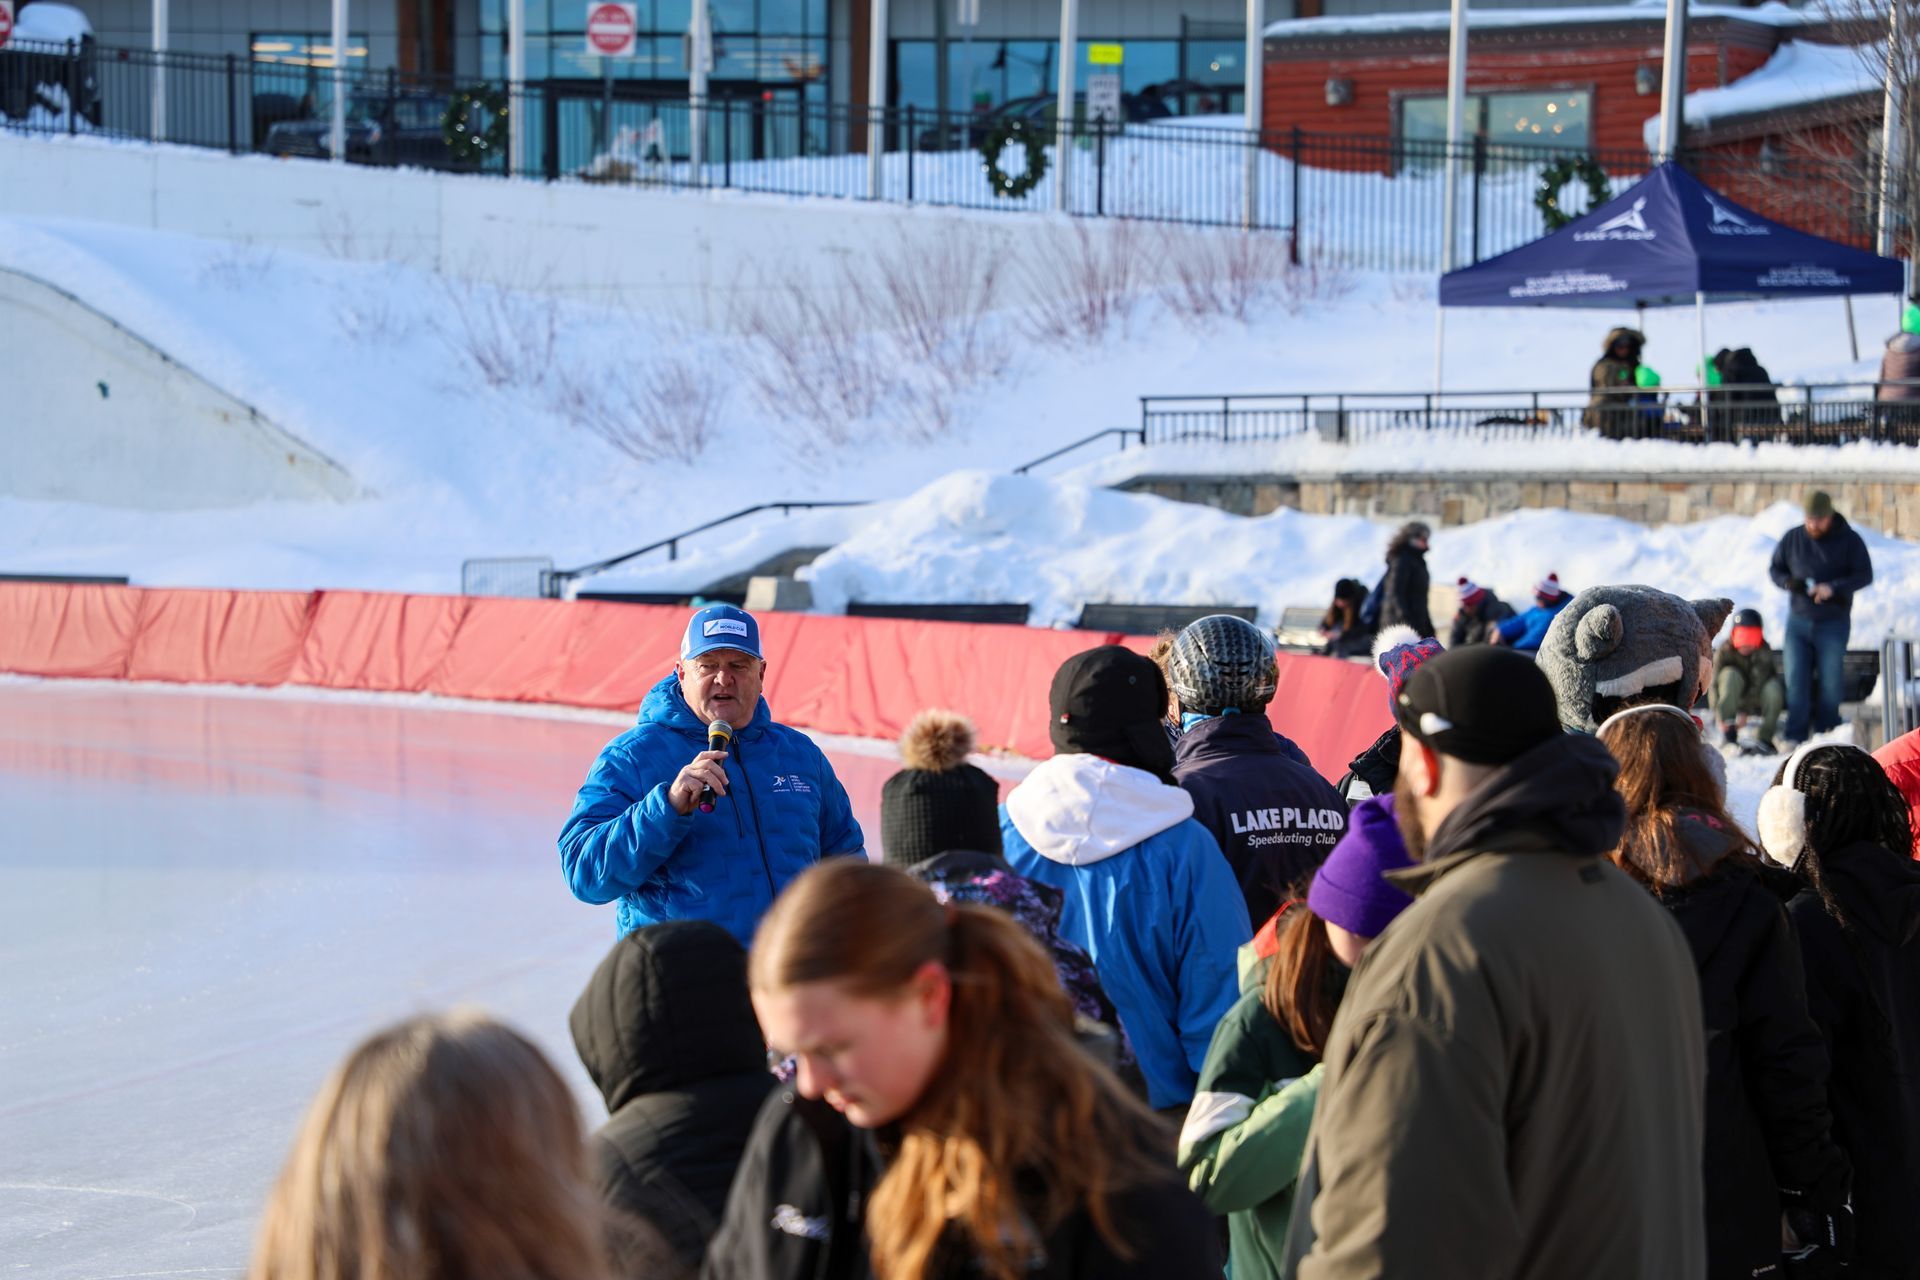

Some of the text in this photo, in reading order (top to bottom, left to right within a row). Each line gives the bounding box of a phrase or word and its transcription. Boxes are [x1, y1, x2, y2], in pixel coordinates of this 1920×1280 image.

[1230, 807, 1344, 834] LAKE PLACID
[1247, 832, 1337, 849] Speedskating Club
